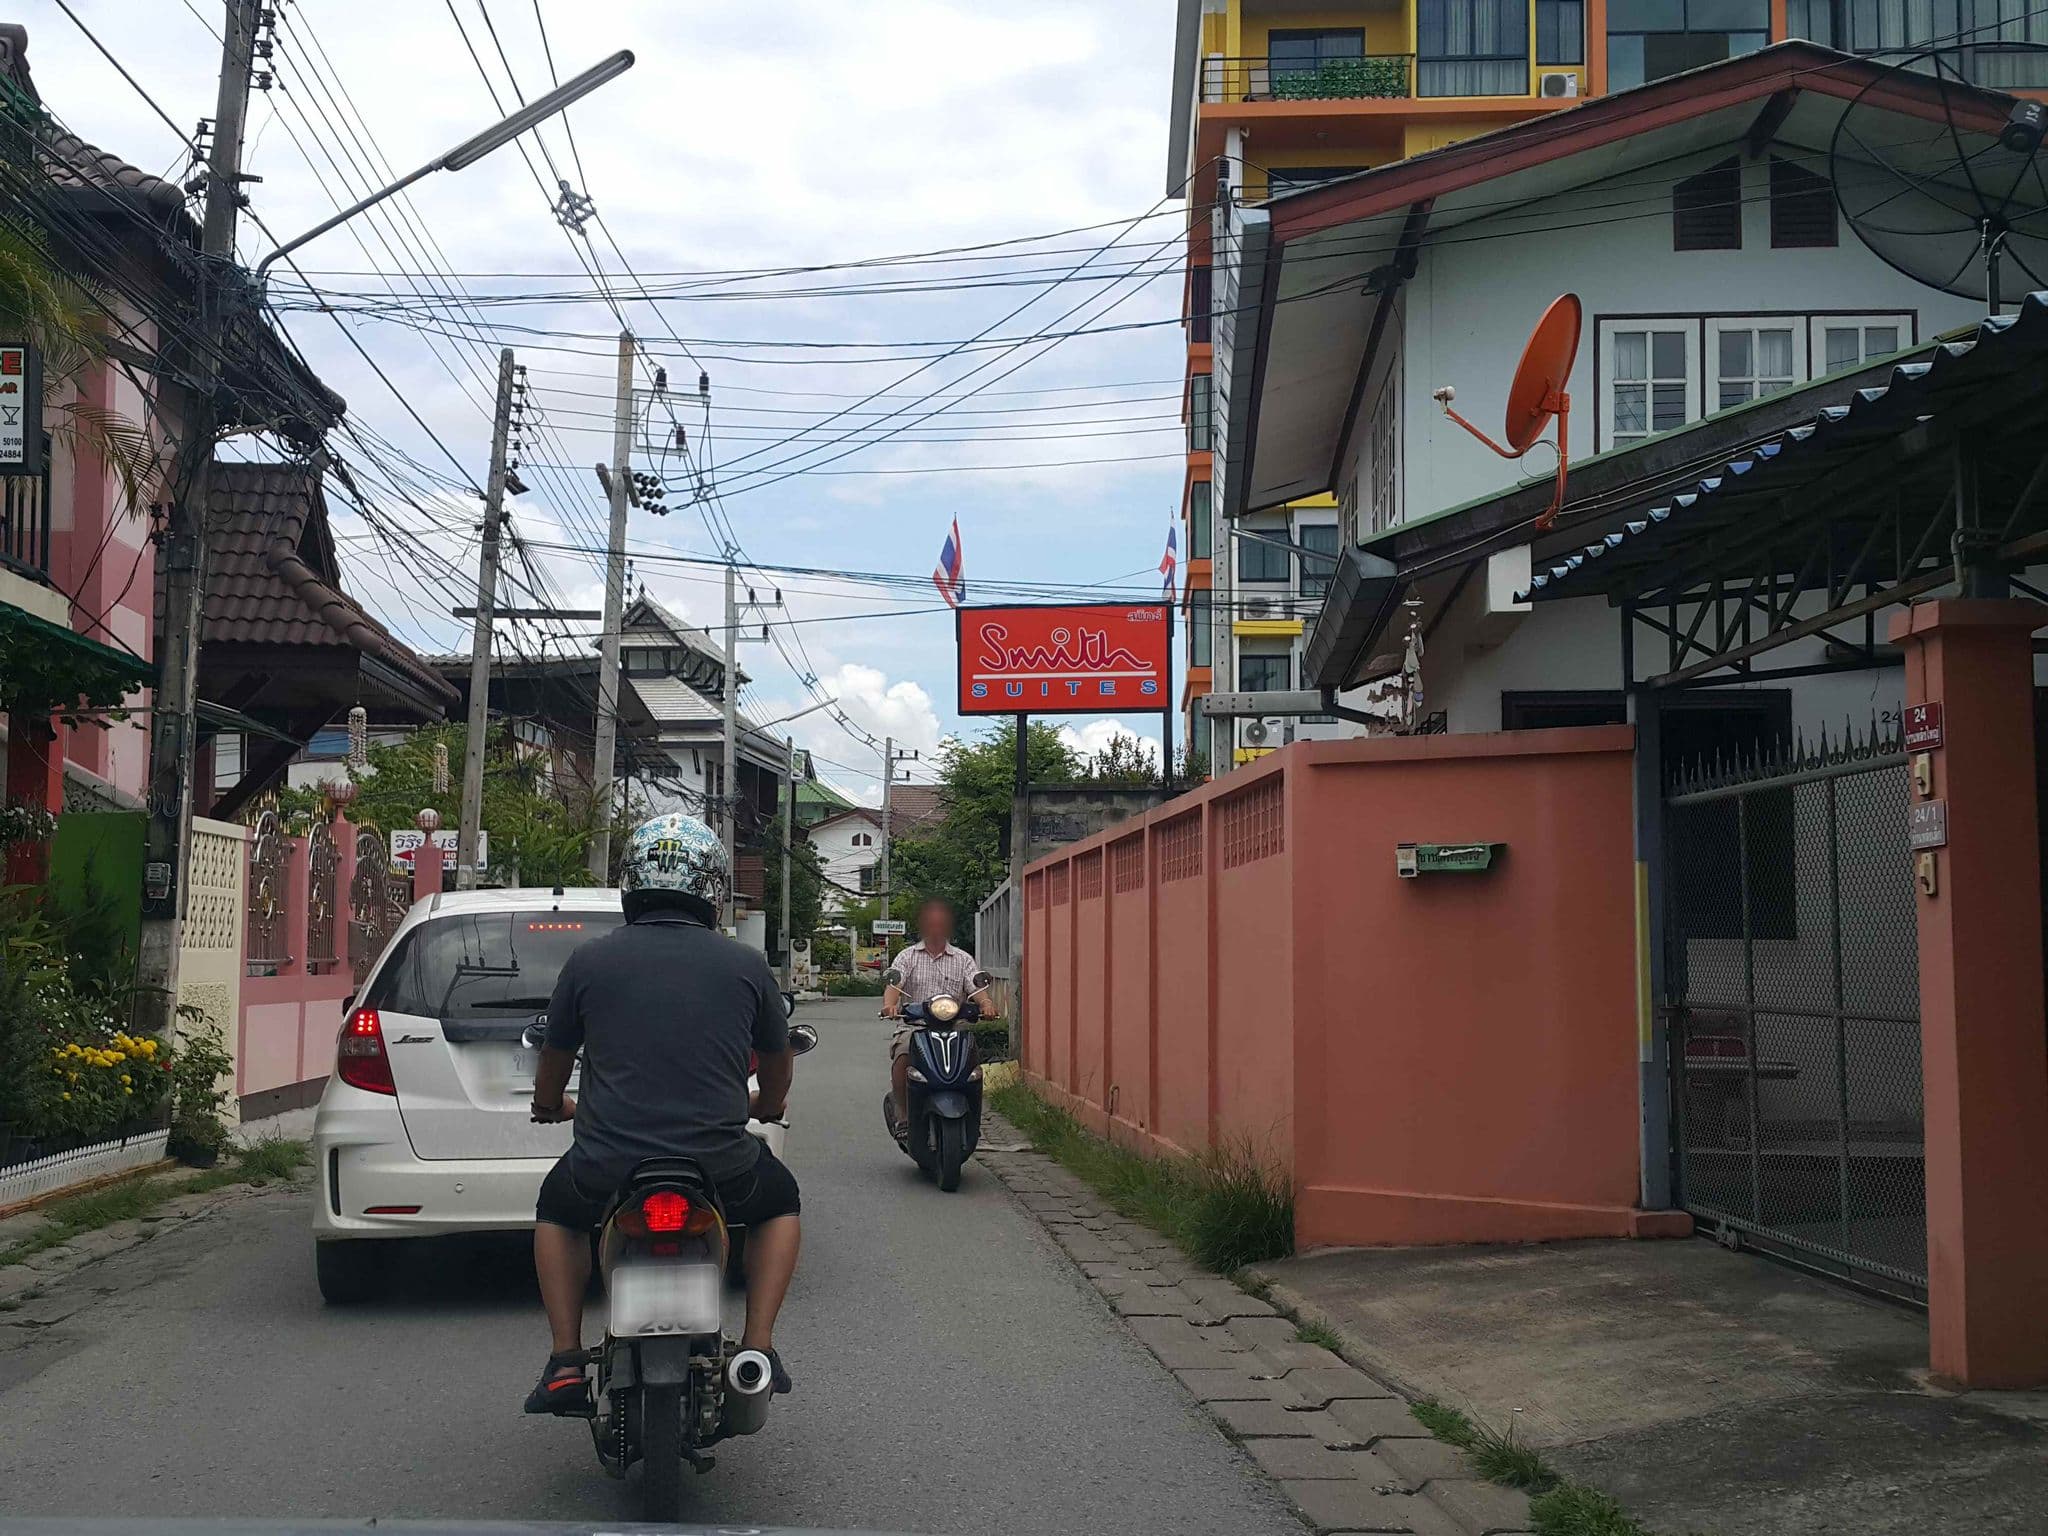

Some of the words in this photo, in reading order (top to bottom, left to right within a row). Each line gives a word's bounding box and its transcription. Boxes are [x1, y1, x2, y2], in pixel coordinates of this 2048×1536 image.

[2, 436, 22, 446] 50100
[979, 622, 1153, 671] Smith
[971, 681, 1158, 697] SUITES
[1914, 706, 1927, 723] 24
[1914, 805, 1937, 823] 24/1
